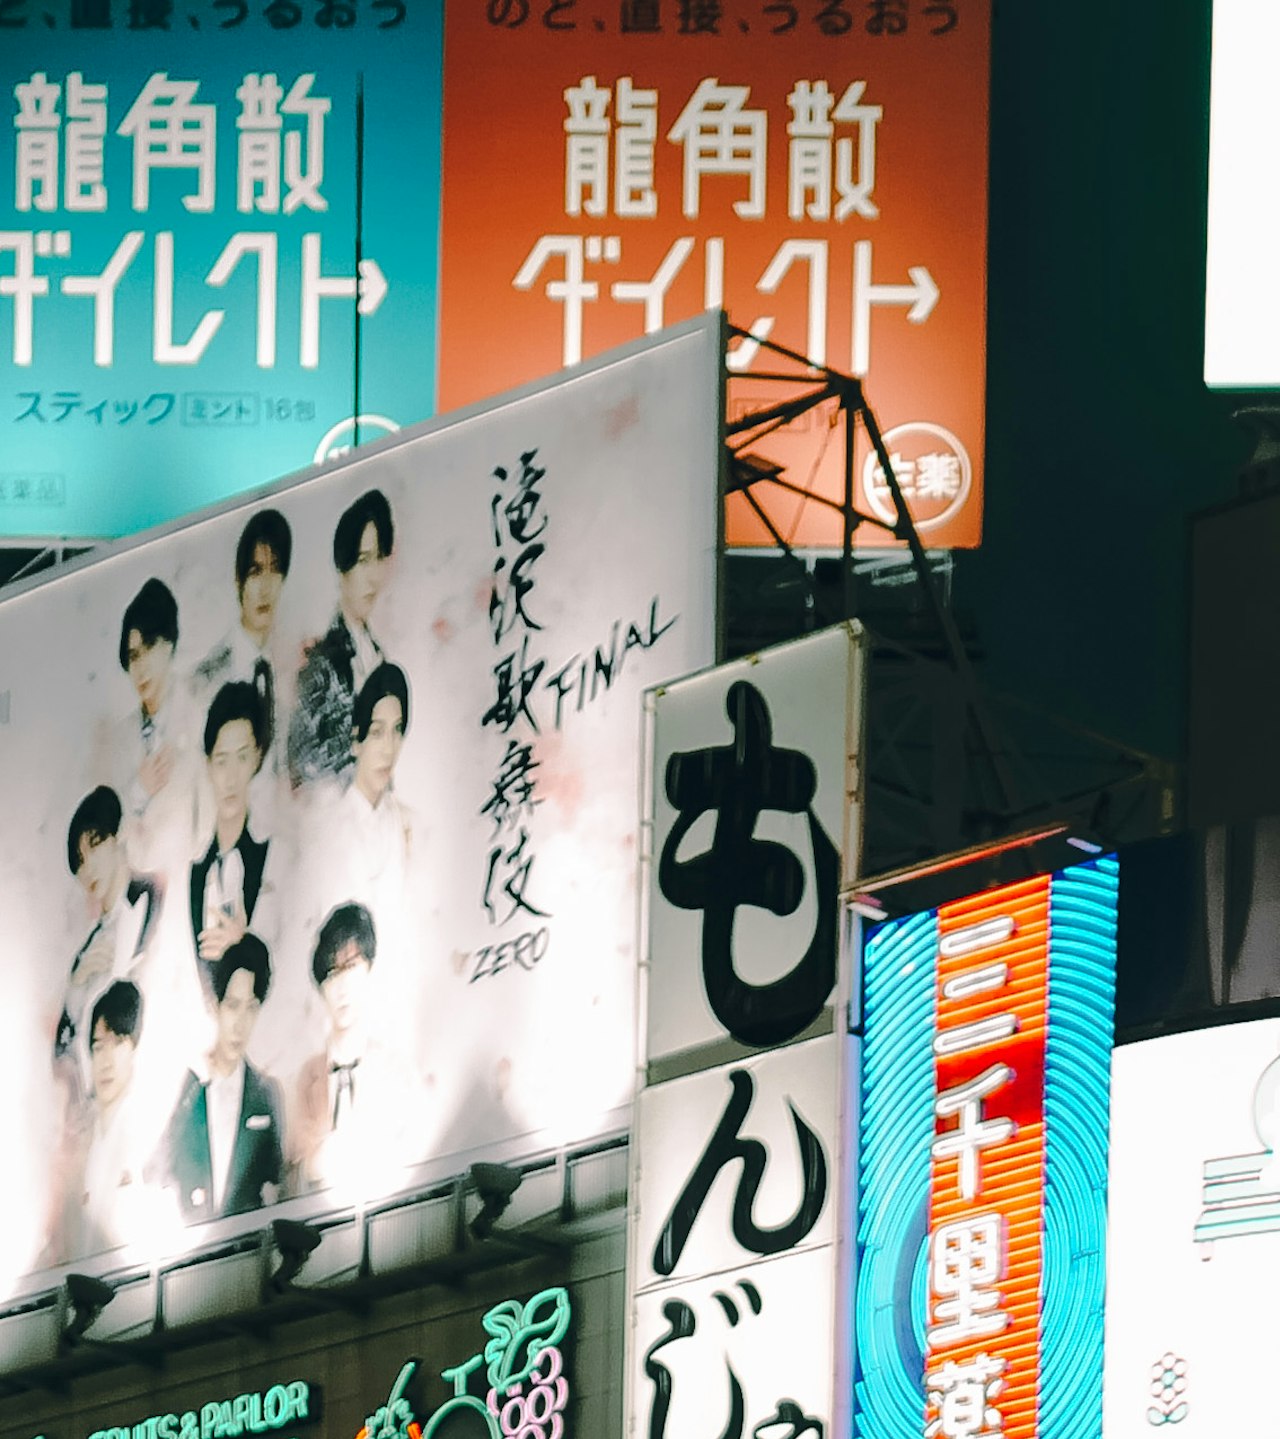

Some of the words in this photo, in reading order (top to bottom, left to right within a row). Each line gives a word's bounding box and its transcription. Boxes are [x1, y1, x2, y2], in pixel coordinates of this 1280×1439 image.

[14, 71, 332, 214] 龍角散
[563, 75, 883, 222] 龍角散
[546, 595, 680, 730] FINAL
[468, 926, 551, 983] ZERO
